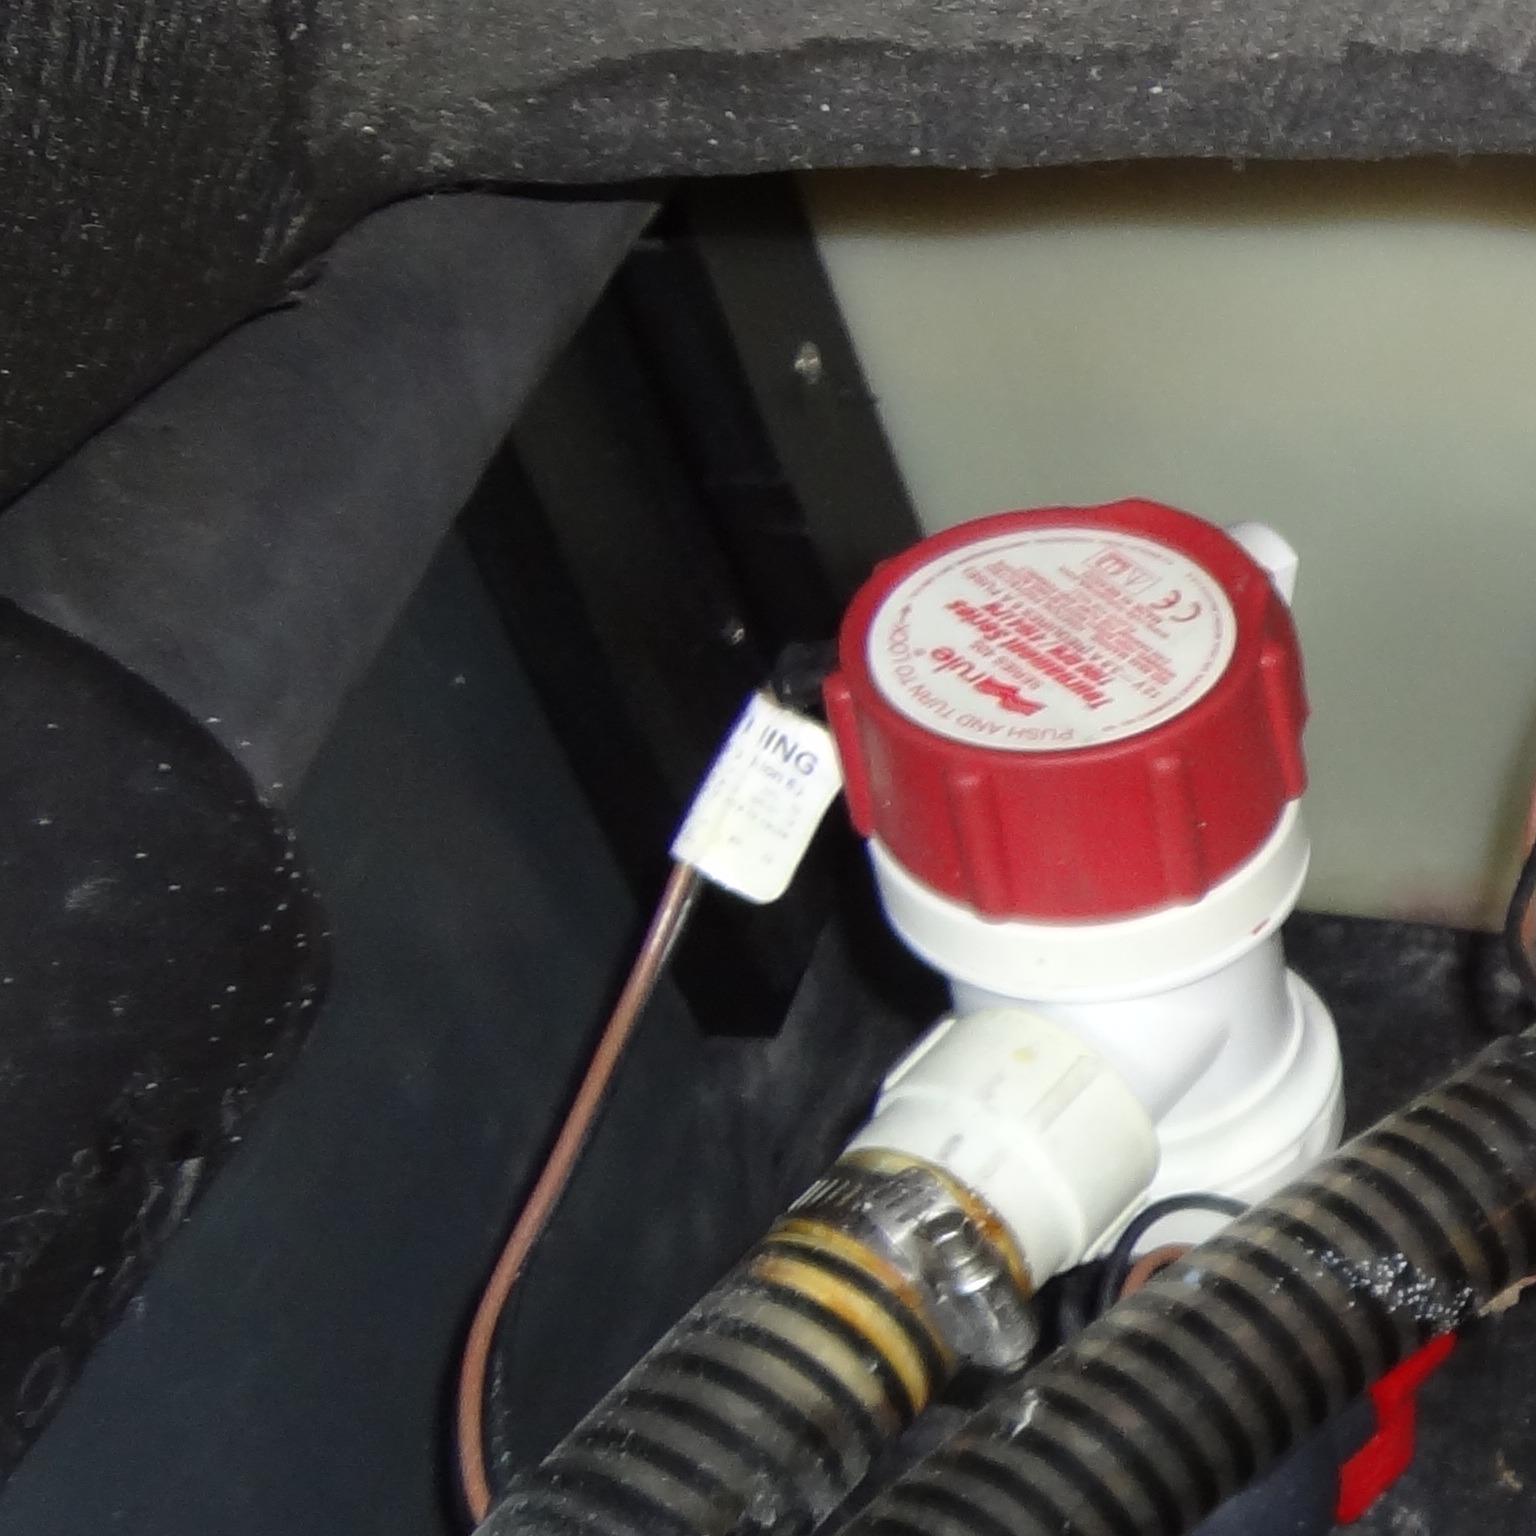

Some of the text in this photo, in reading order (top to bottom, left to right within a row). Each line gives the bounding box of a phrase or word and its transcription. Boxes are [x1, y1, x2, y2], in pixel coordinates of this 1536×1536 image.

[943, 600, 1007, 643] Series
[894, 664, 918, 687] TO
[930, 646, 988, 686] rule
[909, 684, 956, 719] TURN
[955, 713, 1001, 735] AND
[1007, 726, 1074, 741] PUSH
